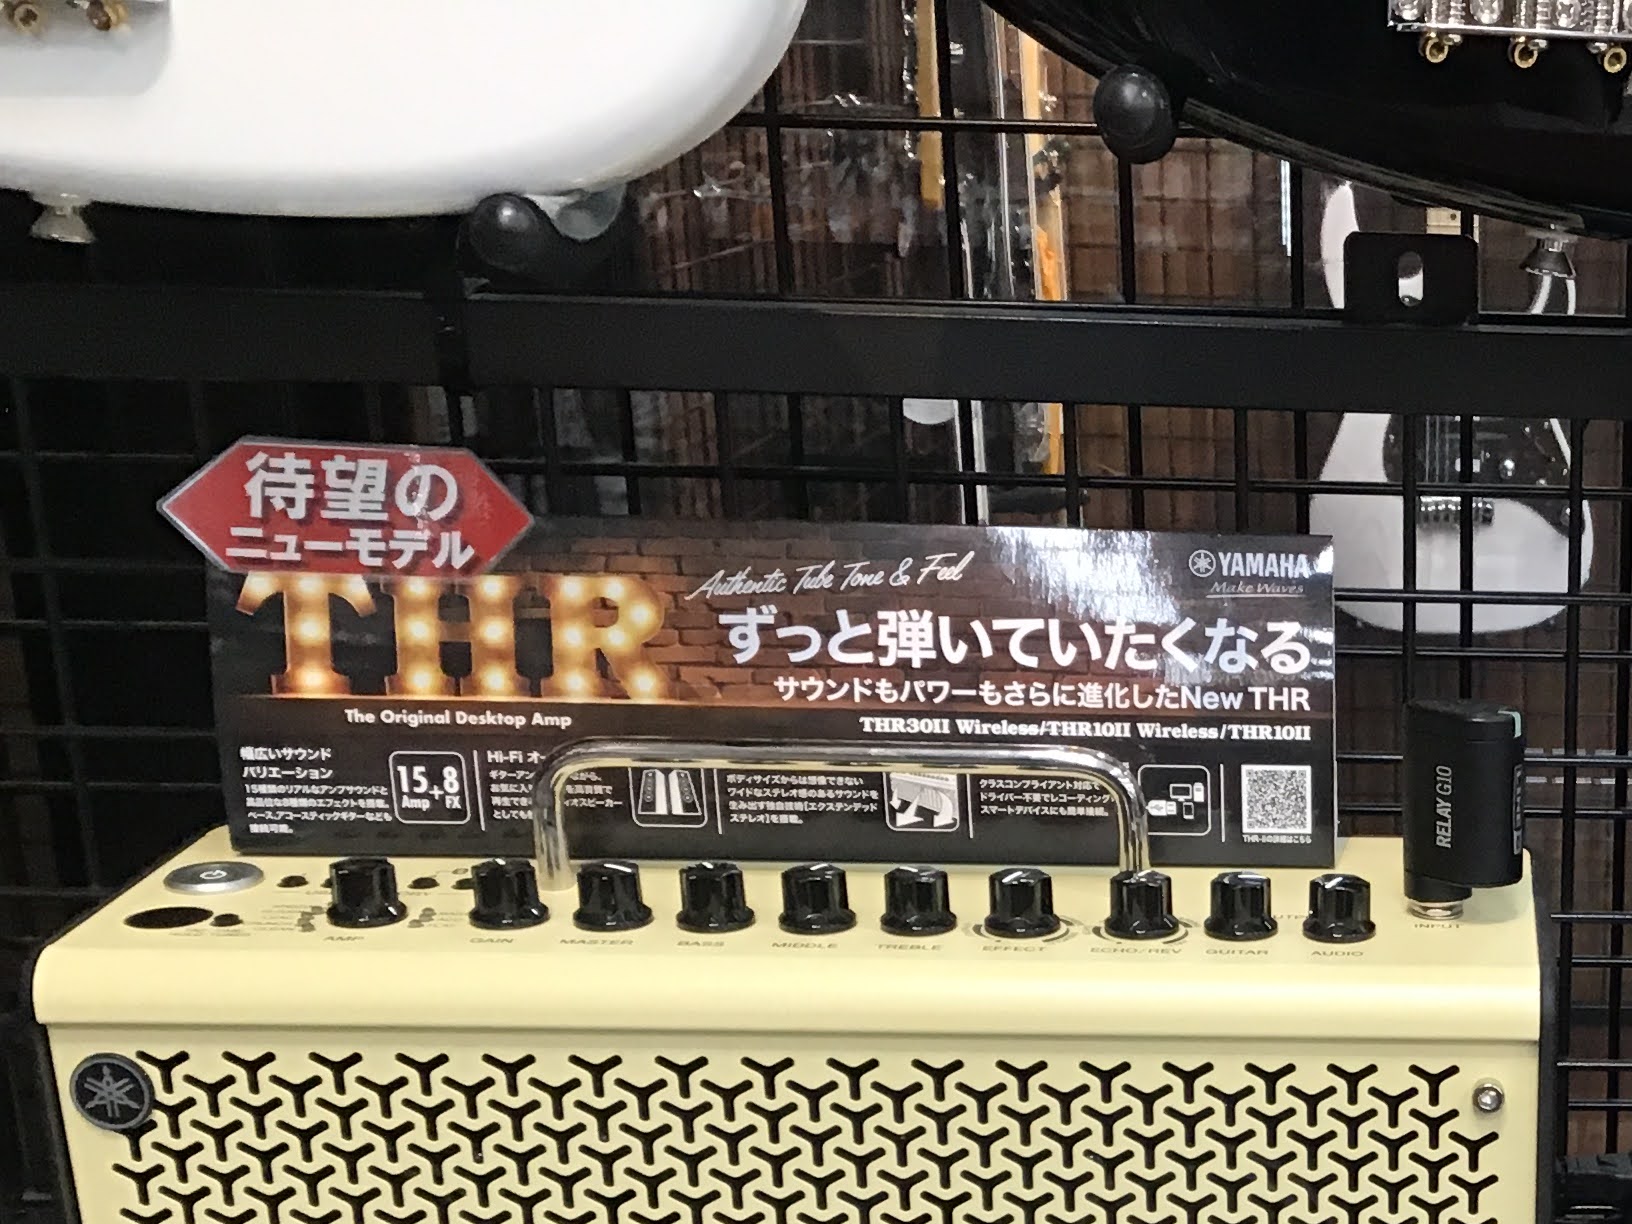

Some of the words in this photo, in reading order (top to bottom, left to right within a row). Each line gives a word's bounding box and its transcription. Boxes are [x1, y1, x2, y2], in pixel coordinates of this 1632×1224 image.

[243, 451, 460, 523] 待望の
[226, 526, 475, 571] ニューモデル
[685, 566, 787, 600] Authentic
[793, 560, 836, 595] Tube
[840, 561, 885, 591] Tone
[888, 557, 914, 587] &
[917, 551, 975, 584] Feel
[1218, 552, 1310, 579] YAMAHA
[1210, 581, 1252, 593] Make
[1256, 582, 1304, 593] Waves
[236, 573, 673, 700] THR
[718, 607, 1311, 674] ずっと弾いていたくなる
[1249, 687, 1311, 711] THR
[345, 709, 375, 725] The
[381, 709, 450, 728] Original
[455, 710, 526, 729] Desktop
[531, 712, 572, 730] Amp
[860, 717, 950, 734] THR30II
[487, 751, 522, 763] Hi-Fi
[242, 766, 333, 779] バリエーション
[397, 765, 428, 793] 15
[442, 766, 460, 793] 8
[1435, 765, 1452, 797] G10
[401, 796, 430, 811] Amp
[445, 796, 462, 809] FX
[1435, 797, 1452, 848] RELAY
